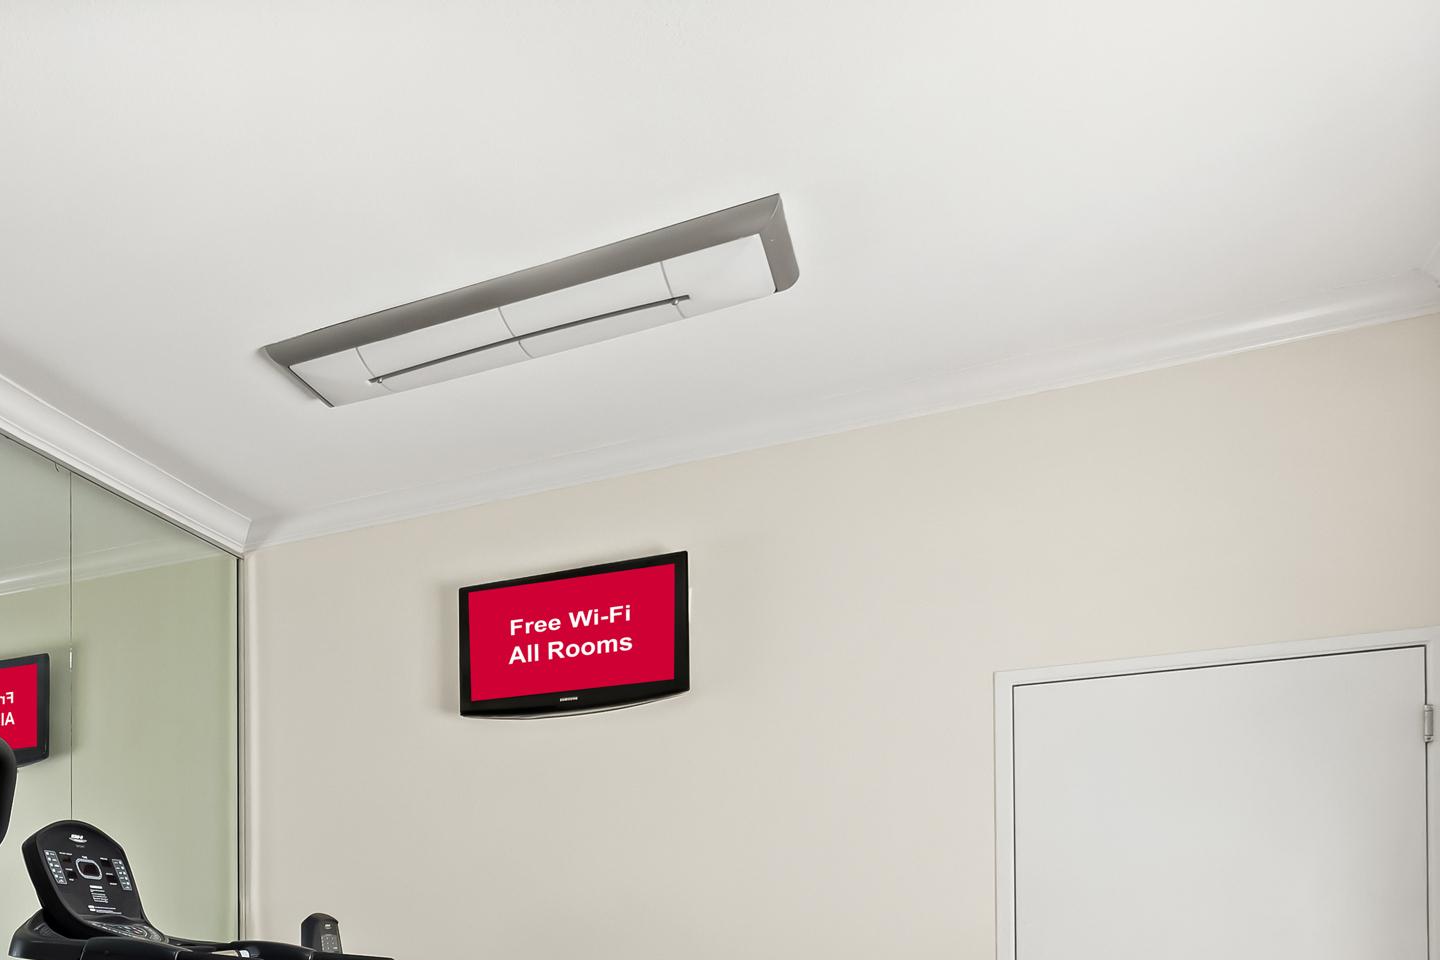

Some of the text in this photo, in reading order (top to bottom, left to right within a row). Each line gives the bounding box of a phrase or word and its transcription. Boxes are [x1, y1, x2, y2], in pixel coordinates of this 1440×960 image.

[510, 605, 631, 636] Free Wi-Fi
[508, 636, 633, 665] All Rooms
